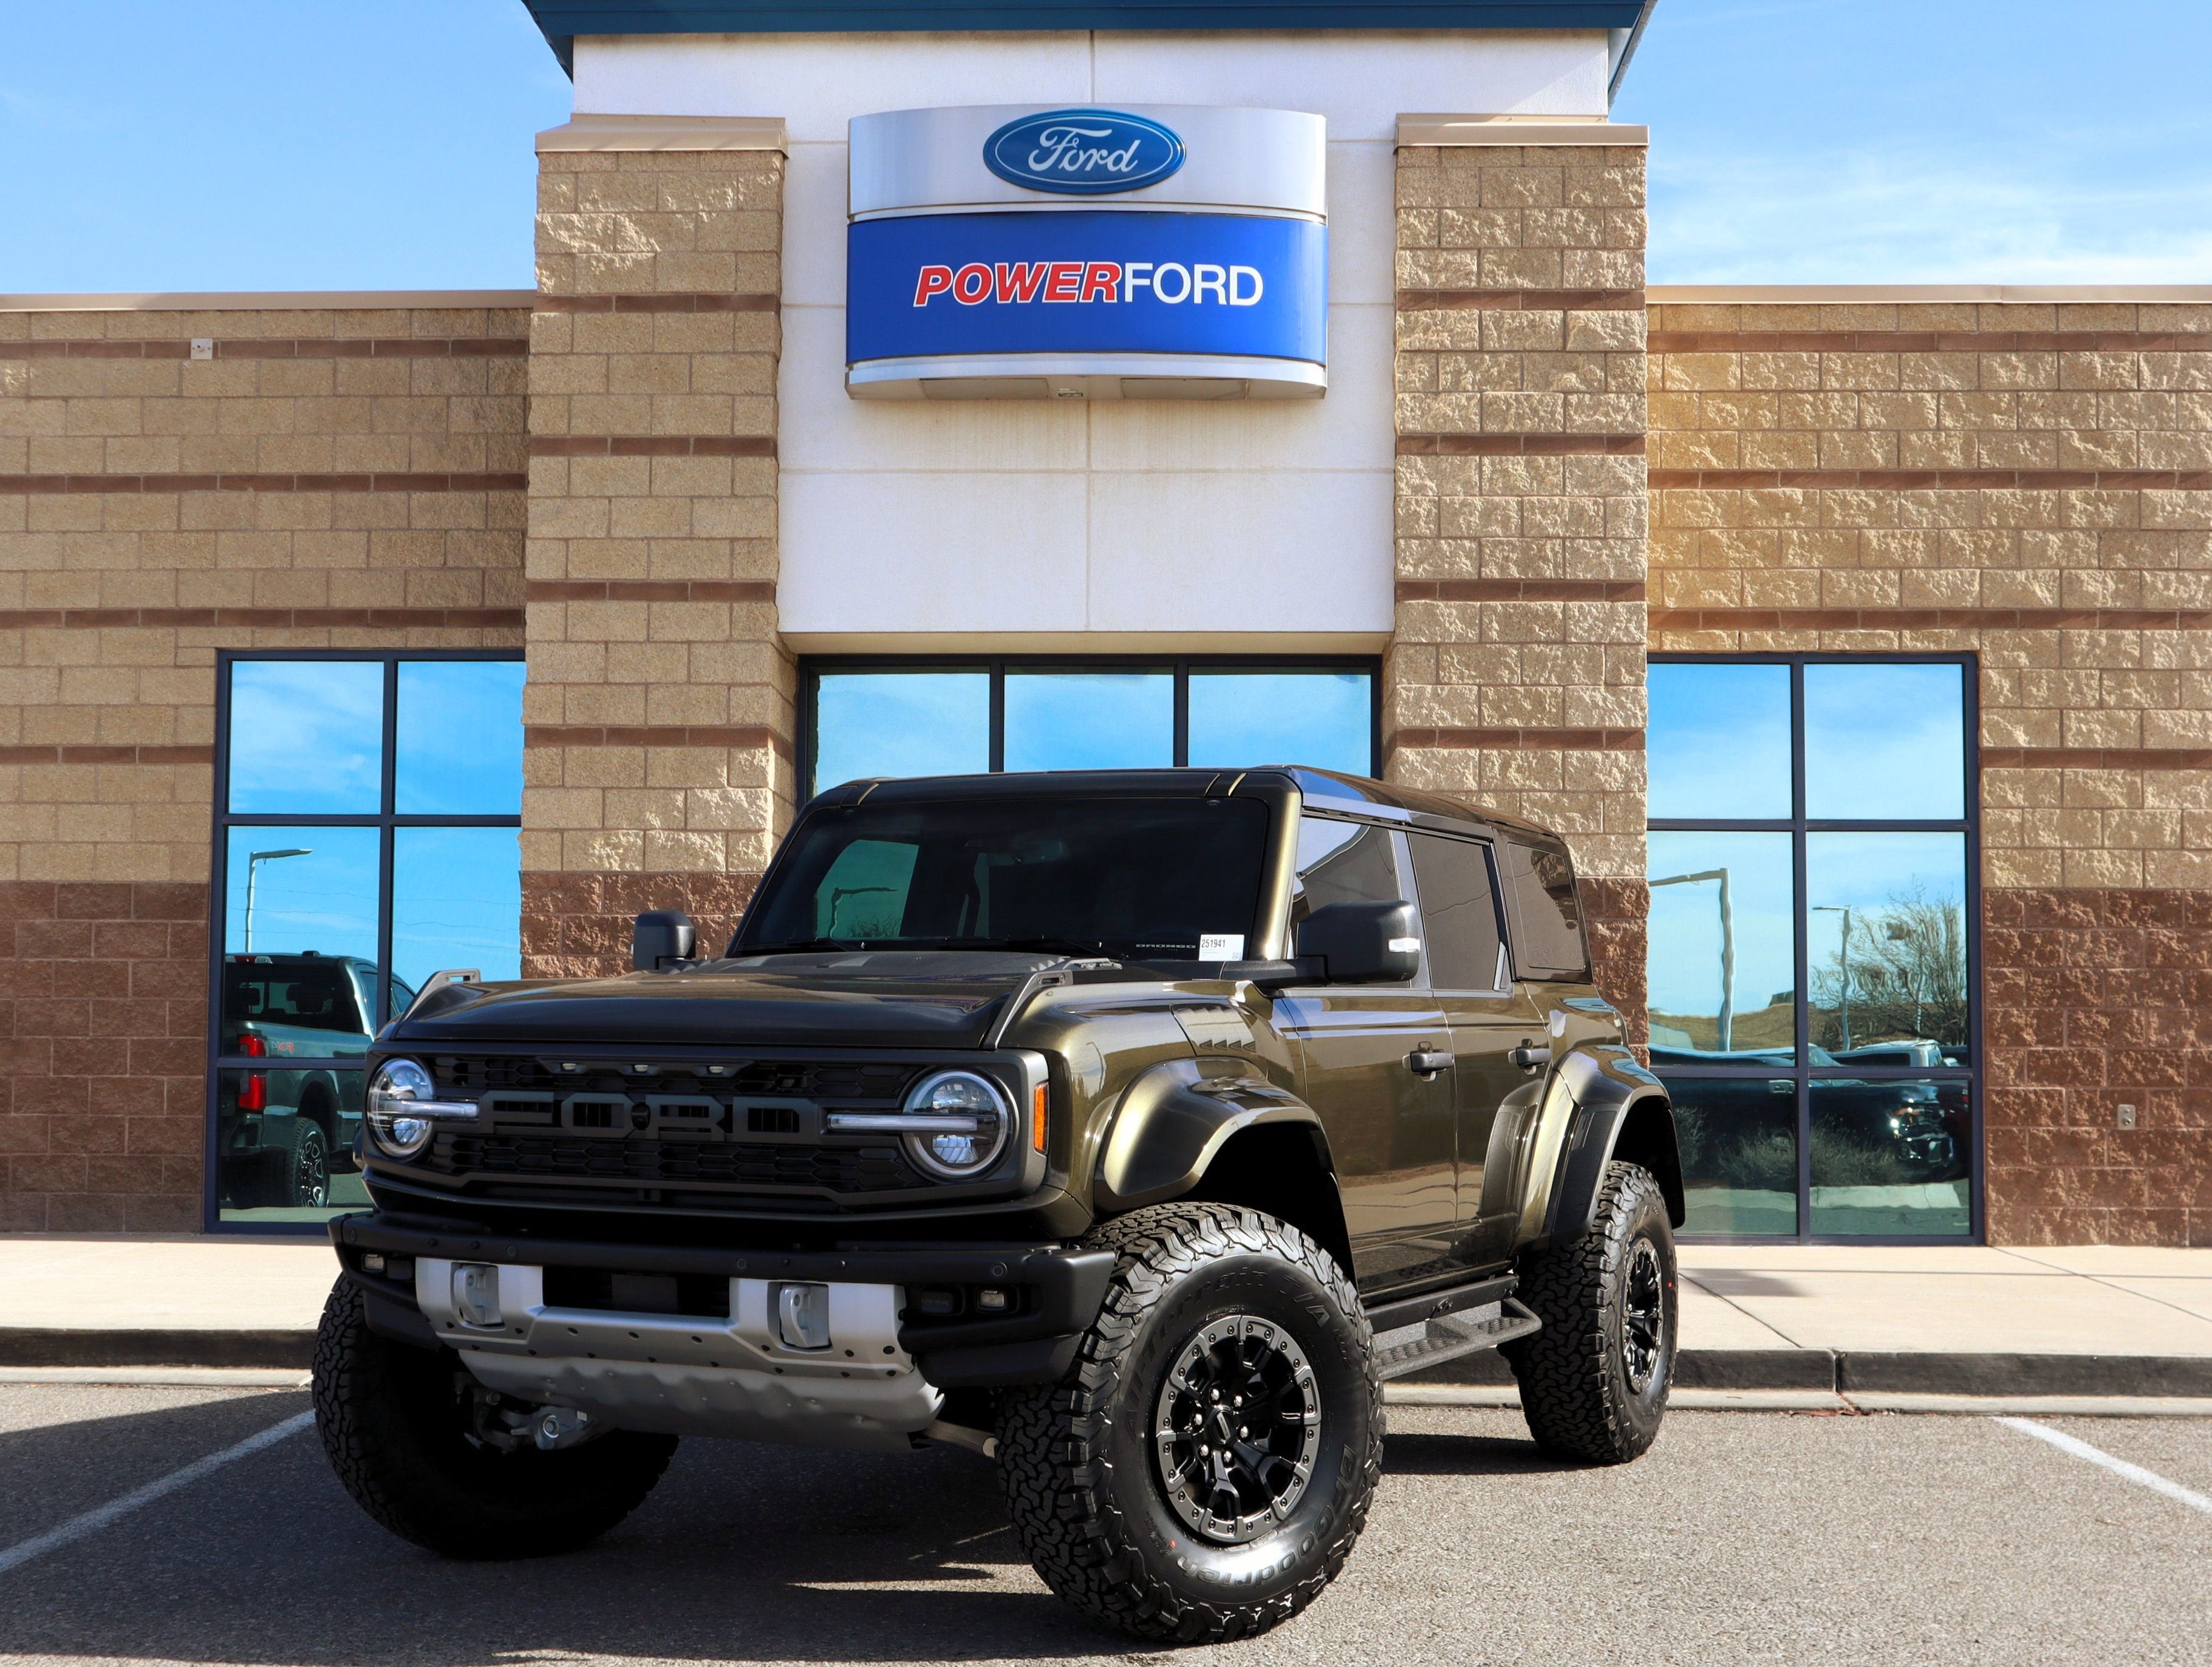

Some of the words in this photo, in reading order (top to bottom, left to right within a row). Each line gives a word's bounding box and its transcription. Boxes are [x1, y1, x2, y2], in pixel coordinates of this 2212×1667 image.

[1028, 126, 1141, 172] Ford
[1201, 938, 1226, 948] 251941
[480, 1091, 814, 1142] FORD
